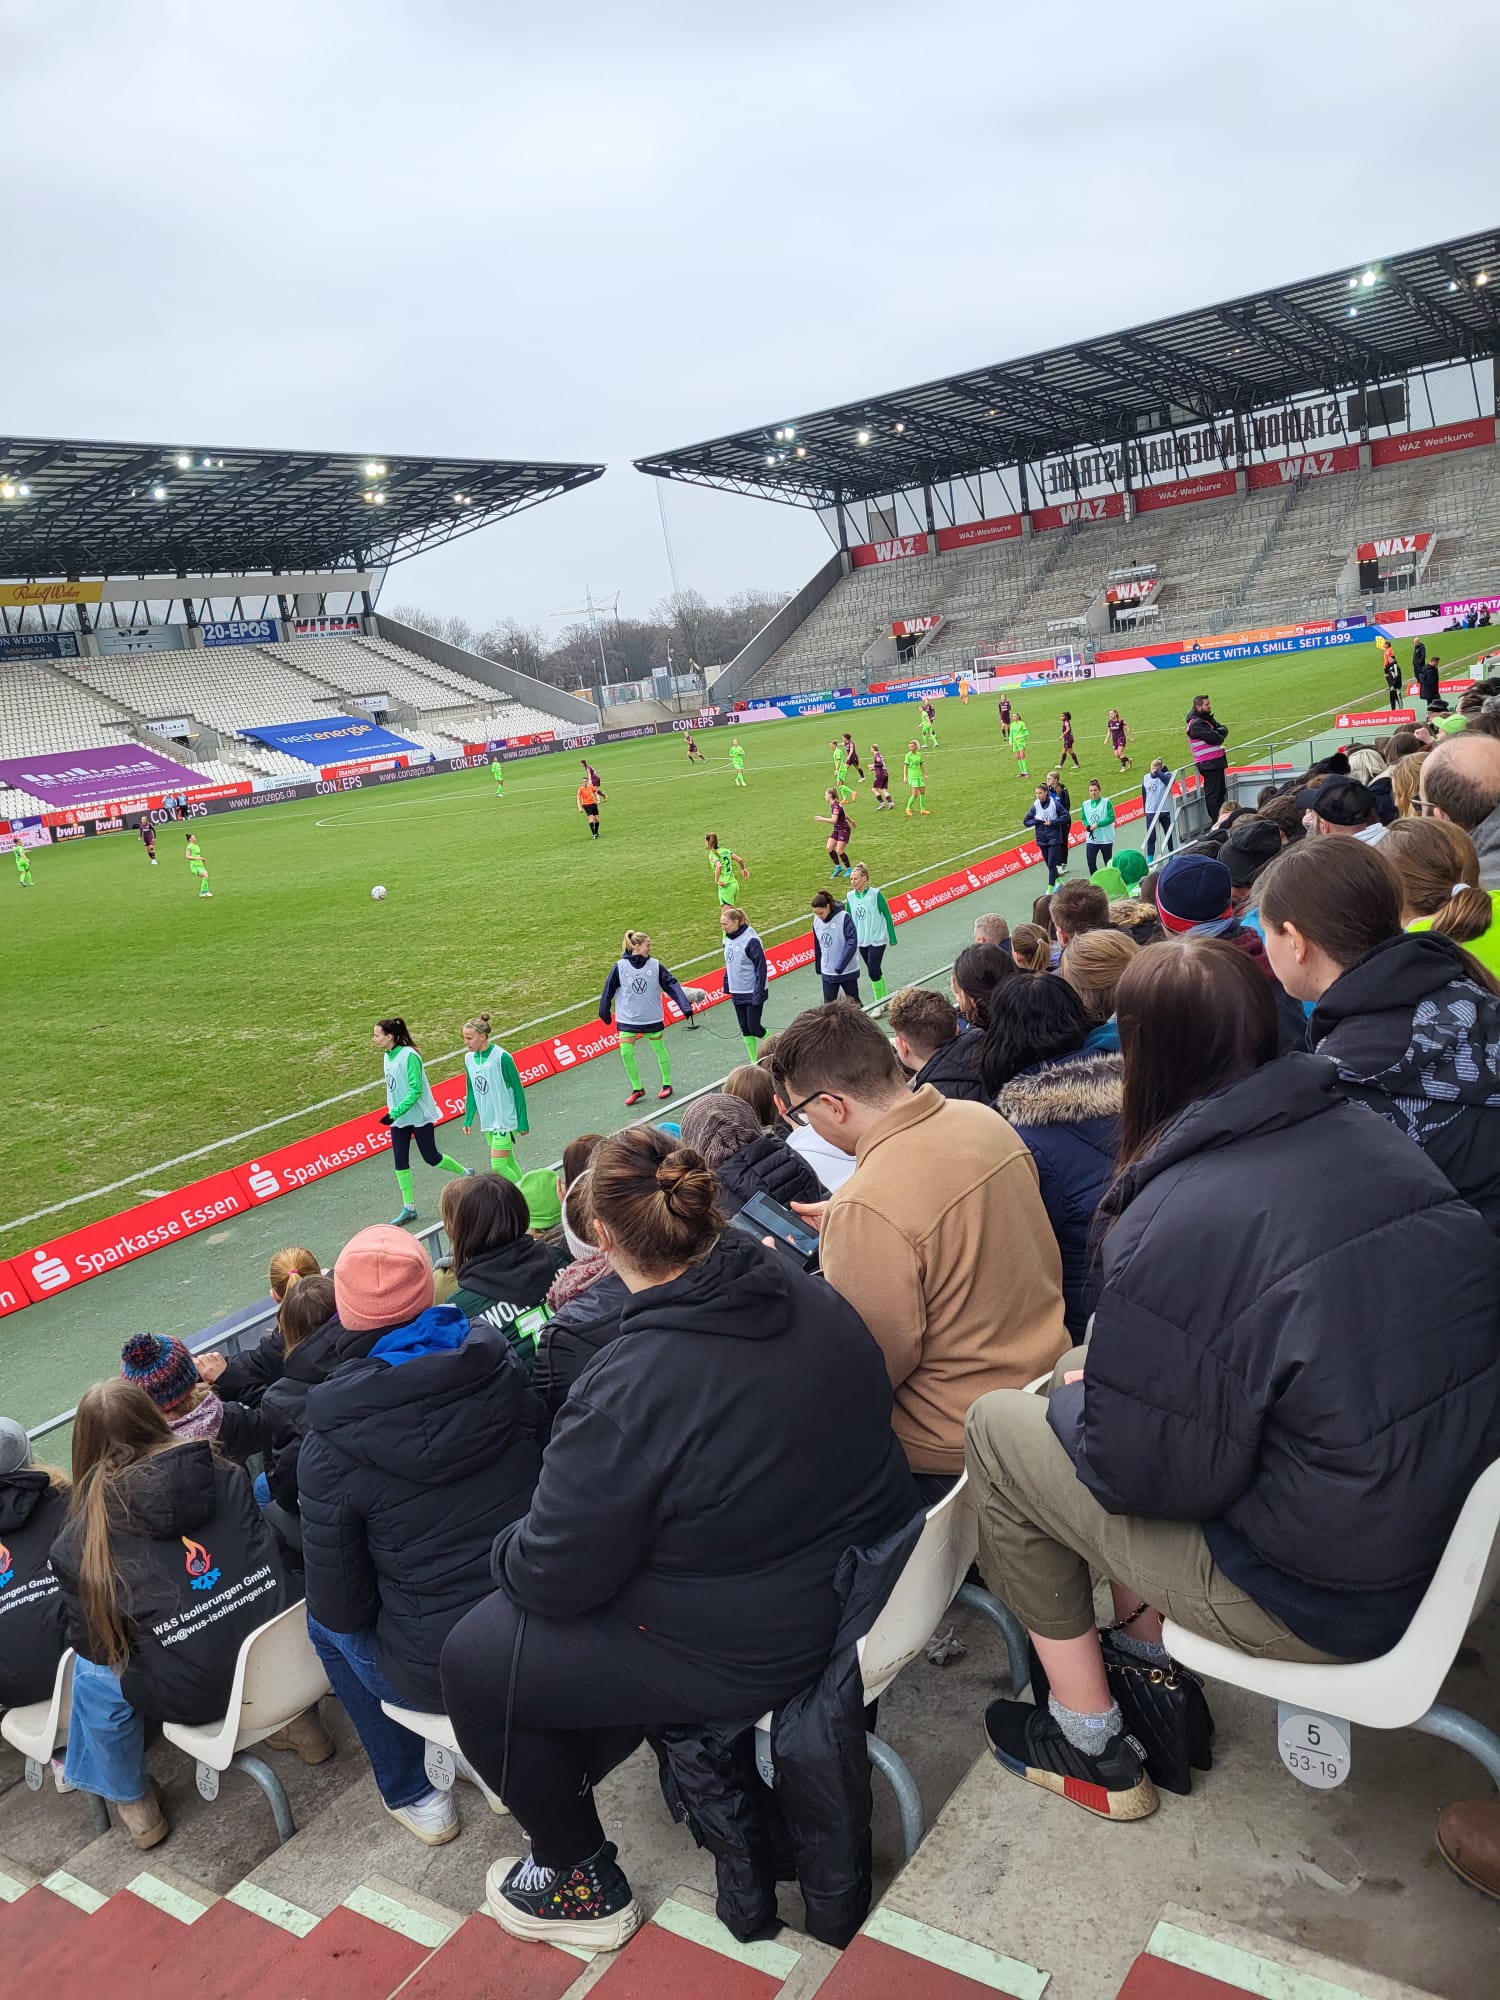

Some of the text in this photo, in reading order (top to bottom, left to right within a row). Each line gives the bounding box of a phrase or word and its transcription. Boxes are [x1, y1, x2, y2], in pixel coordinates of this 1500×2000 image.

[1398, 431, 1474, 453] WAZ Westkurve
[1278, 451, 1335, 482] WAZ
[1059, 499, 1107, 525] WAZ
[874, 537, 916, 562] WAZ
[1374, 535, 1417, 558] WAZ
[1115, 581, 1151, 600] WAZ
[291, 616, 360, 633] WITRA
[903, 617, 933, 634] WAZ
[12, 634, 55, 645] WERDEN
[1180, 633, 1353, 664] SERVICE WITH A SMILE. SEIT 1899.
[852, 694, 890, 707] SECURITY
[907, 687, 948, 700] PERSONAL
[672, 716, 714, 731] CONZEPS
[1351, 714, 1410, 726] Sparkasse Essen
[277, 723, 373, 745] westenergie
[562, 735, 596, 750] CONZEPS
[450, 753, 489, 771] CONZEPS
[379, 764, 435, 782] www.conzeps.de
[316, 775, 363, 795] CONZEPS
[228, 788, 297, 809] www.conzeps.de
[56, 823, 85, 838] bwin
[95, 816, 123, 831] bwin
[978, 861, 1021, 885] Sparkasse Essen
[892, 883, 969, 922] ssen Sparkasse Essen
[577, 1030, 621, 1058] Sparkas
[520, 1063, 549, 1084] ssen
[283, 1128, 393, 1187] Sparkasse Ess
[75, 1193, 239, 1275] Sparkasse Essen
[28, 1575, 59, 1589] GmbH
[153, 1565, 272, 1636] W&S Isolierungen GmbH
[160, 1578, 277, 1648] info@wus-isolierungen.de
[1307, 1724, 1321, 1746] 5
[436, 1750, 443, 1765] 3
[1289, 1752, 1338, 1779] 53-19
[205, 1767, 210, 1780] 2
[428, 1768, 450, 1785] 53-19
